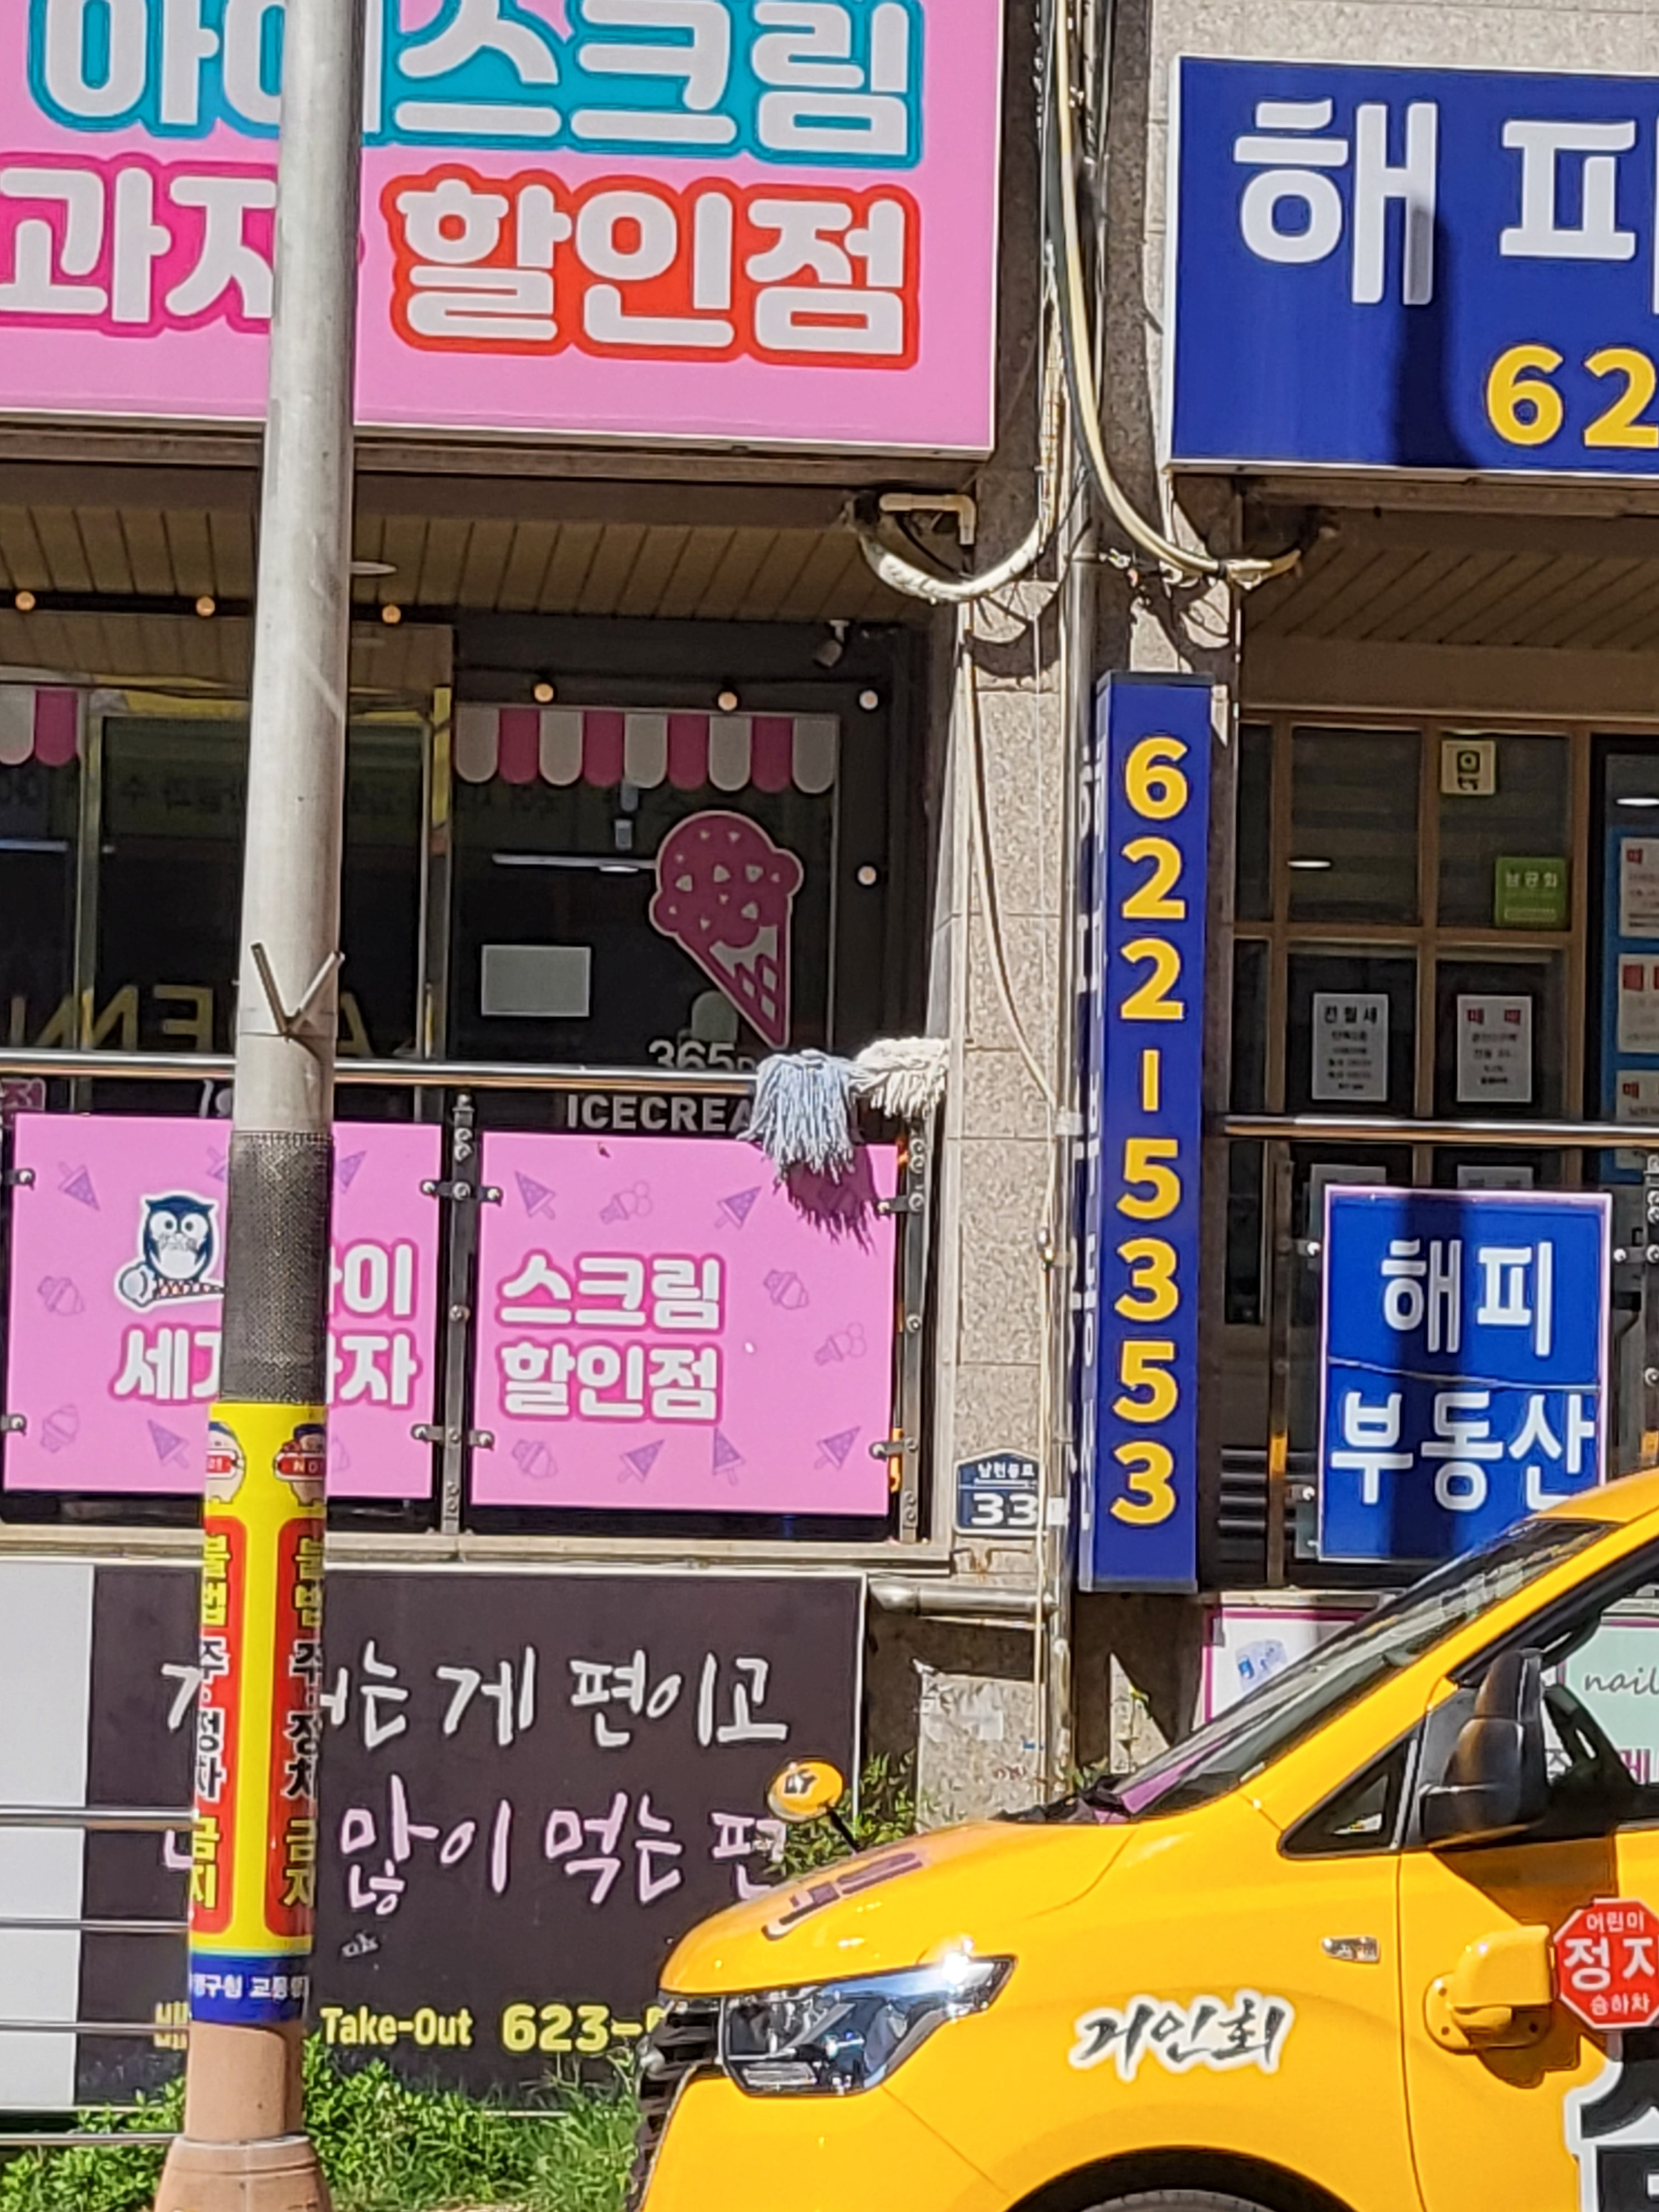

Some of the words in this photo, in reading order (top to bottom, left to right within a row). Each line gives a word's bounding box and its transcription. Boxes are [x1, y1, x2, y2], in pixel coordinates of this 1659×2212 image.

[395, 178, 905, 354] 할인점
[567, 1094, 753, 1133] ICECREA
[1110, 735, 1188, 1525] 622-5353
[500, 1254, 720, 1329] 스크림
[1381, 1239, 1553, 1358] 해피
[113, 1328, 418, 1405] 세자
[501, 1342, 718, 1420] 할인점
[1331, 1390, 1595, 1511] 부동산
[971, 1493, 1039, 1526] 33
[437, 1646, 535, 1746] 게
[570, 1650, 787, 1747] 편이고
[341, 1773, 512, 1915] 많이
[545, 1792, 682, 1904] 먹는
[1586, 1911, 1645, 1934] 어린이
[320, 2007, 473, 2046] Take-Out
